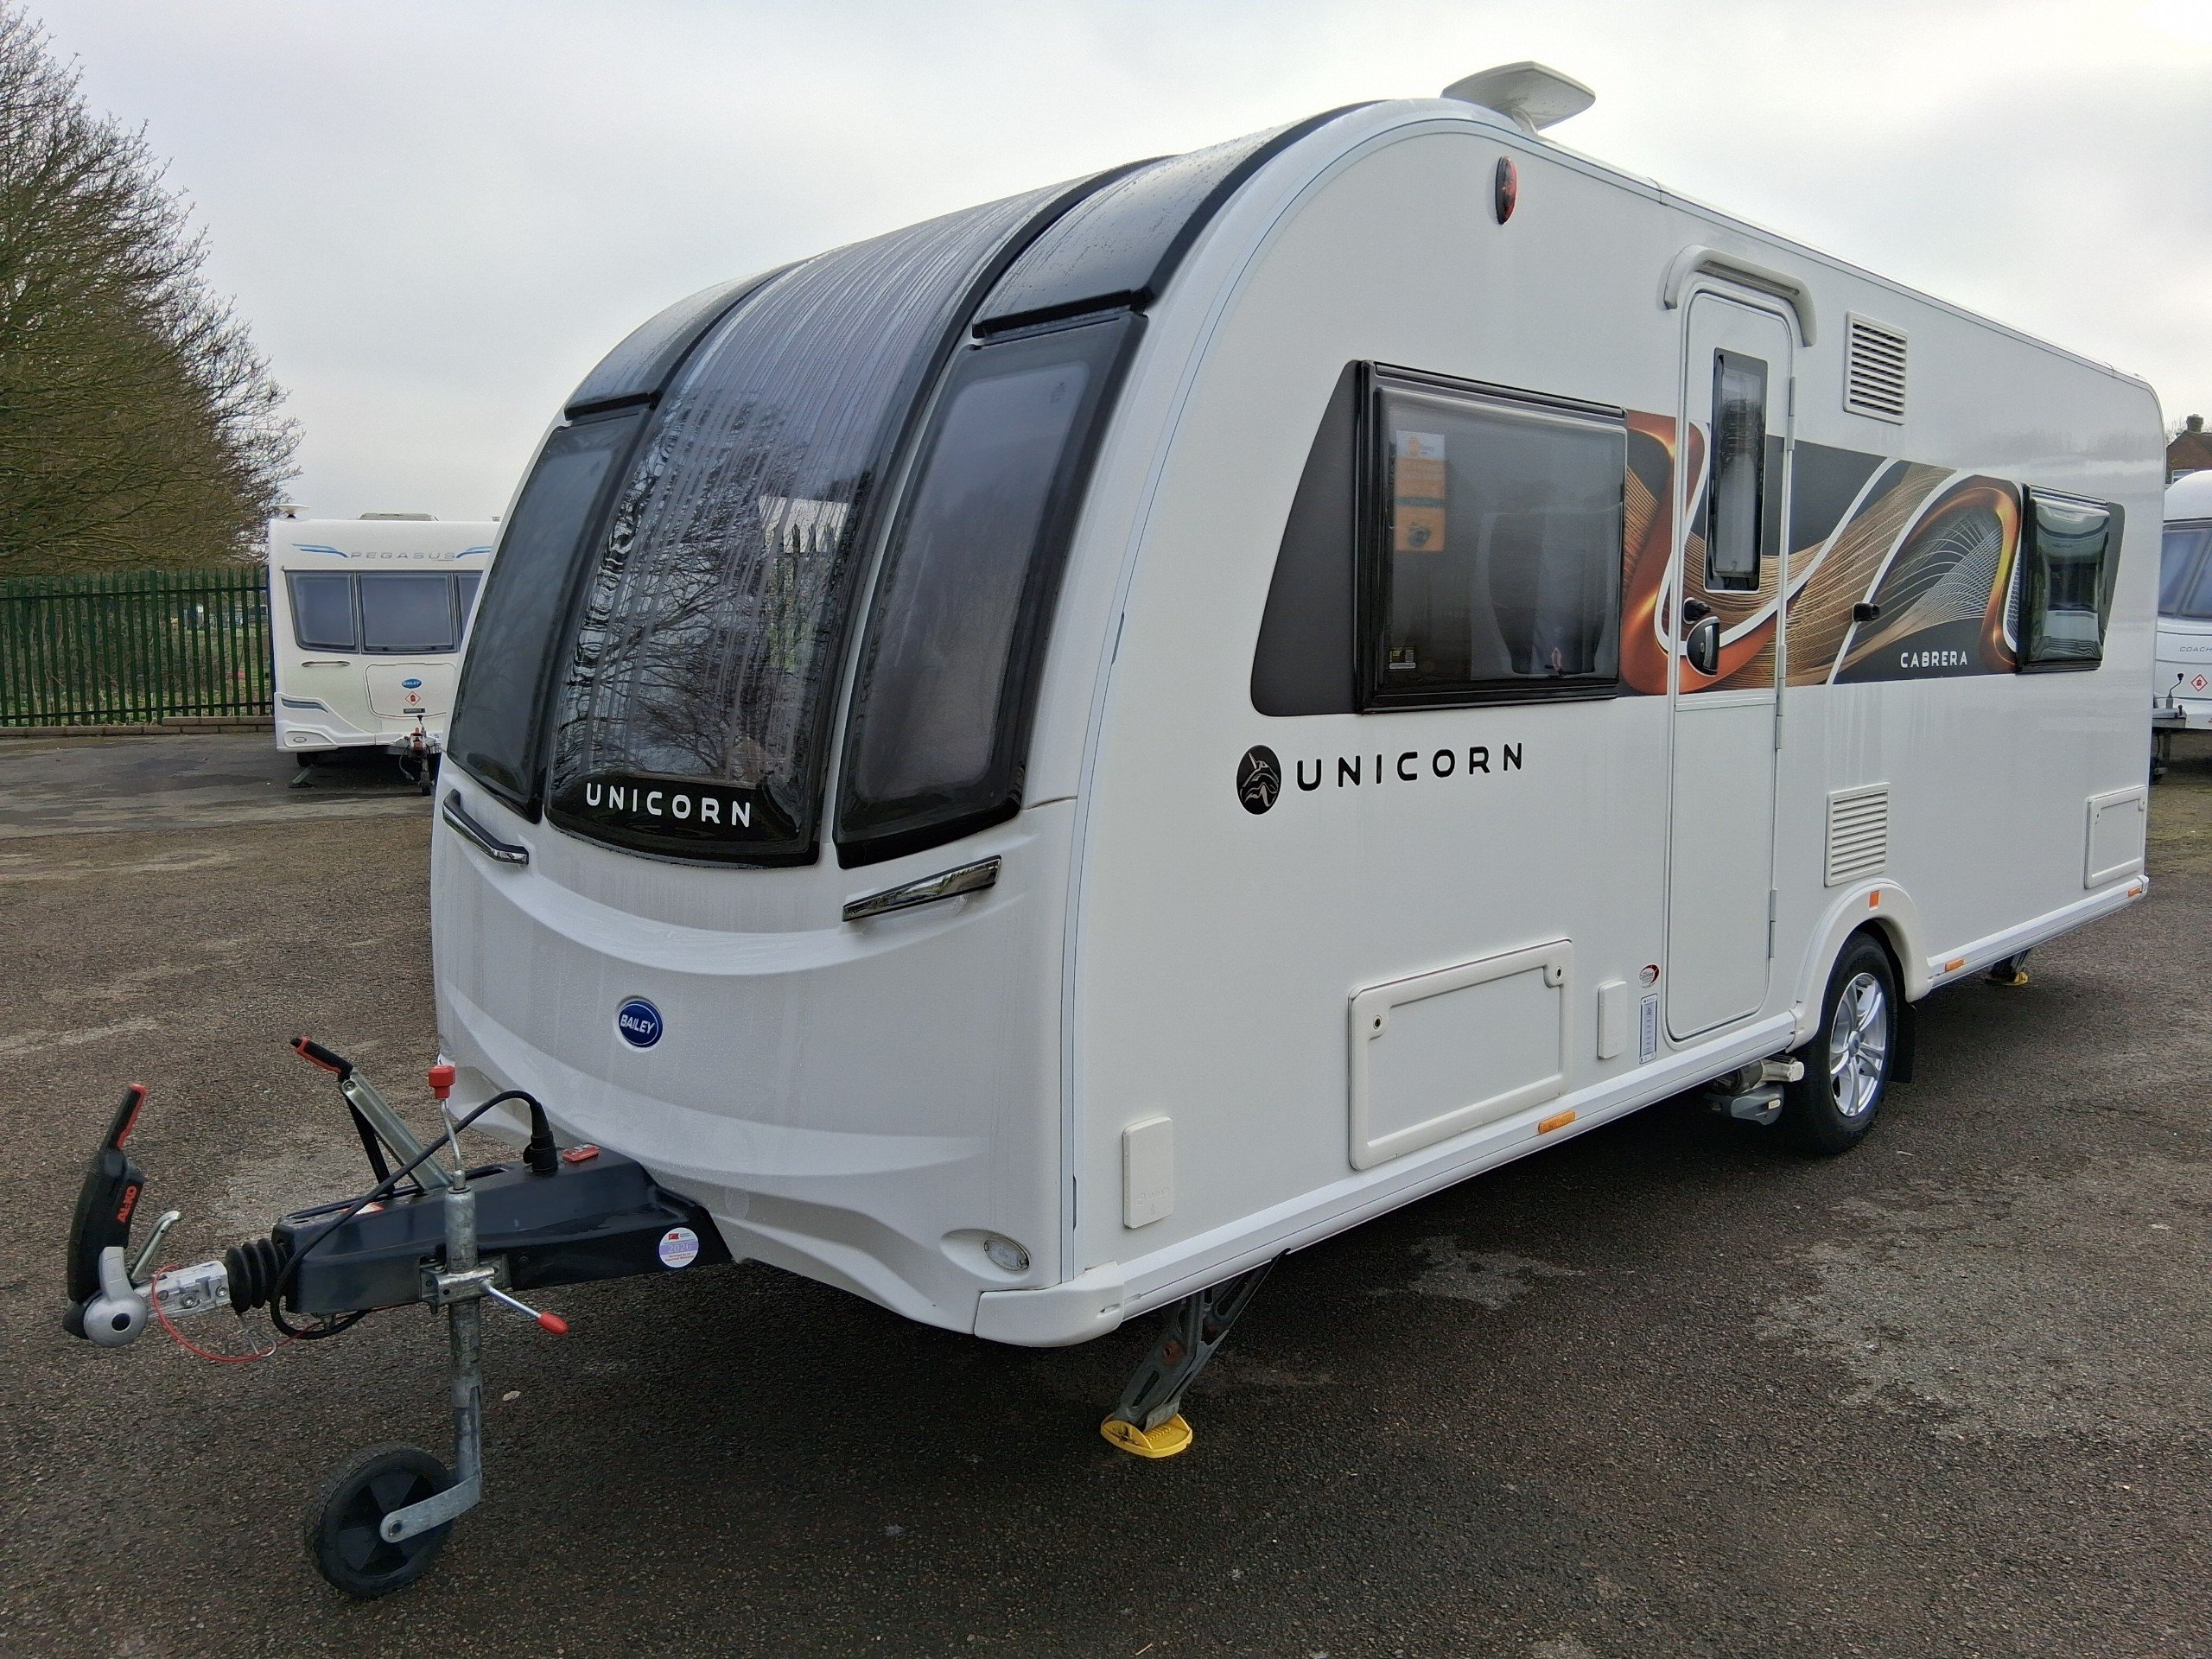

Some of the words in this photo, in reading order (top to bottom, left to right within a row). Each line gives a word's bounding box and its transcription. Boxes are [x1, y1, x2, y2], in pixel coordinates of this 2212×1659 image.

[350, 551, 455, 560] PEGASUS
[1900, 651, 1968, 669] CABRERA
[1296, 742, 1522, 791] UNICORN
[586, 782, 751, 828] UNICORN
[620, 1014, 655, 1034] BAILEY
[668, 1243, 691, 1254] 2026
